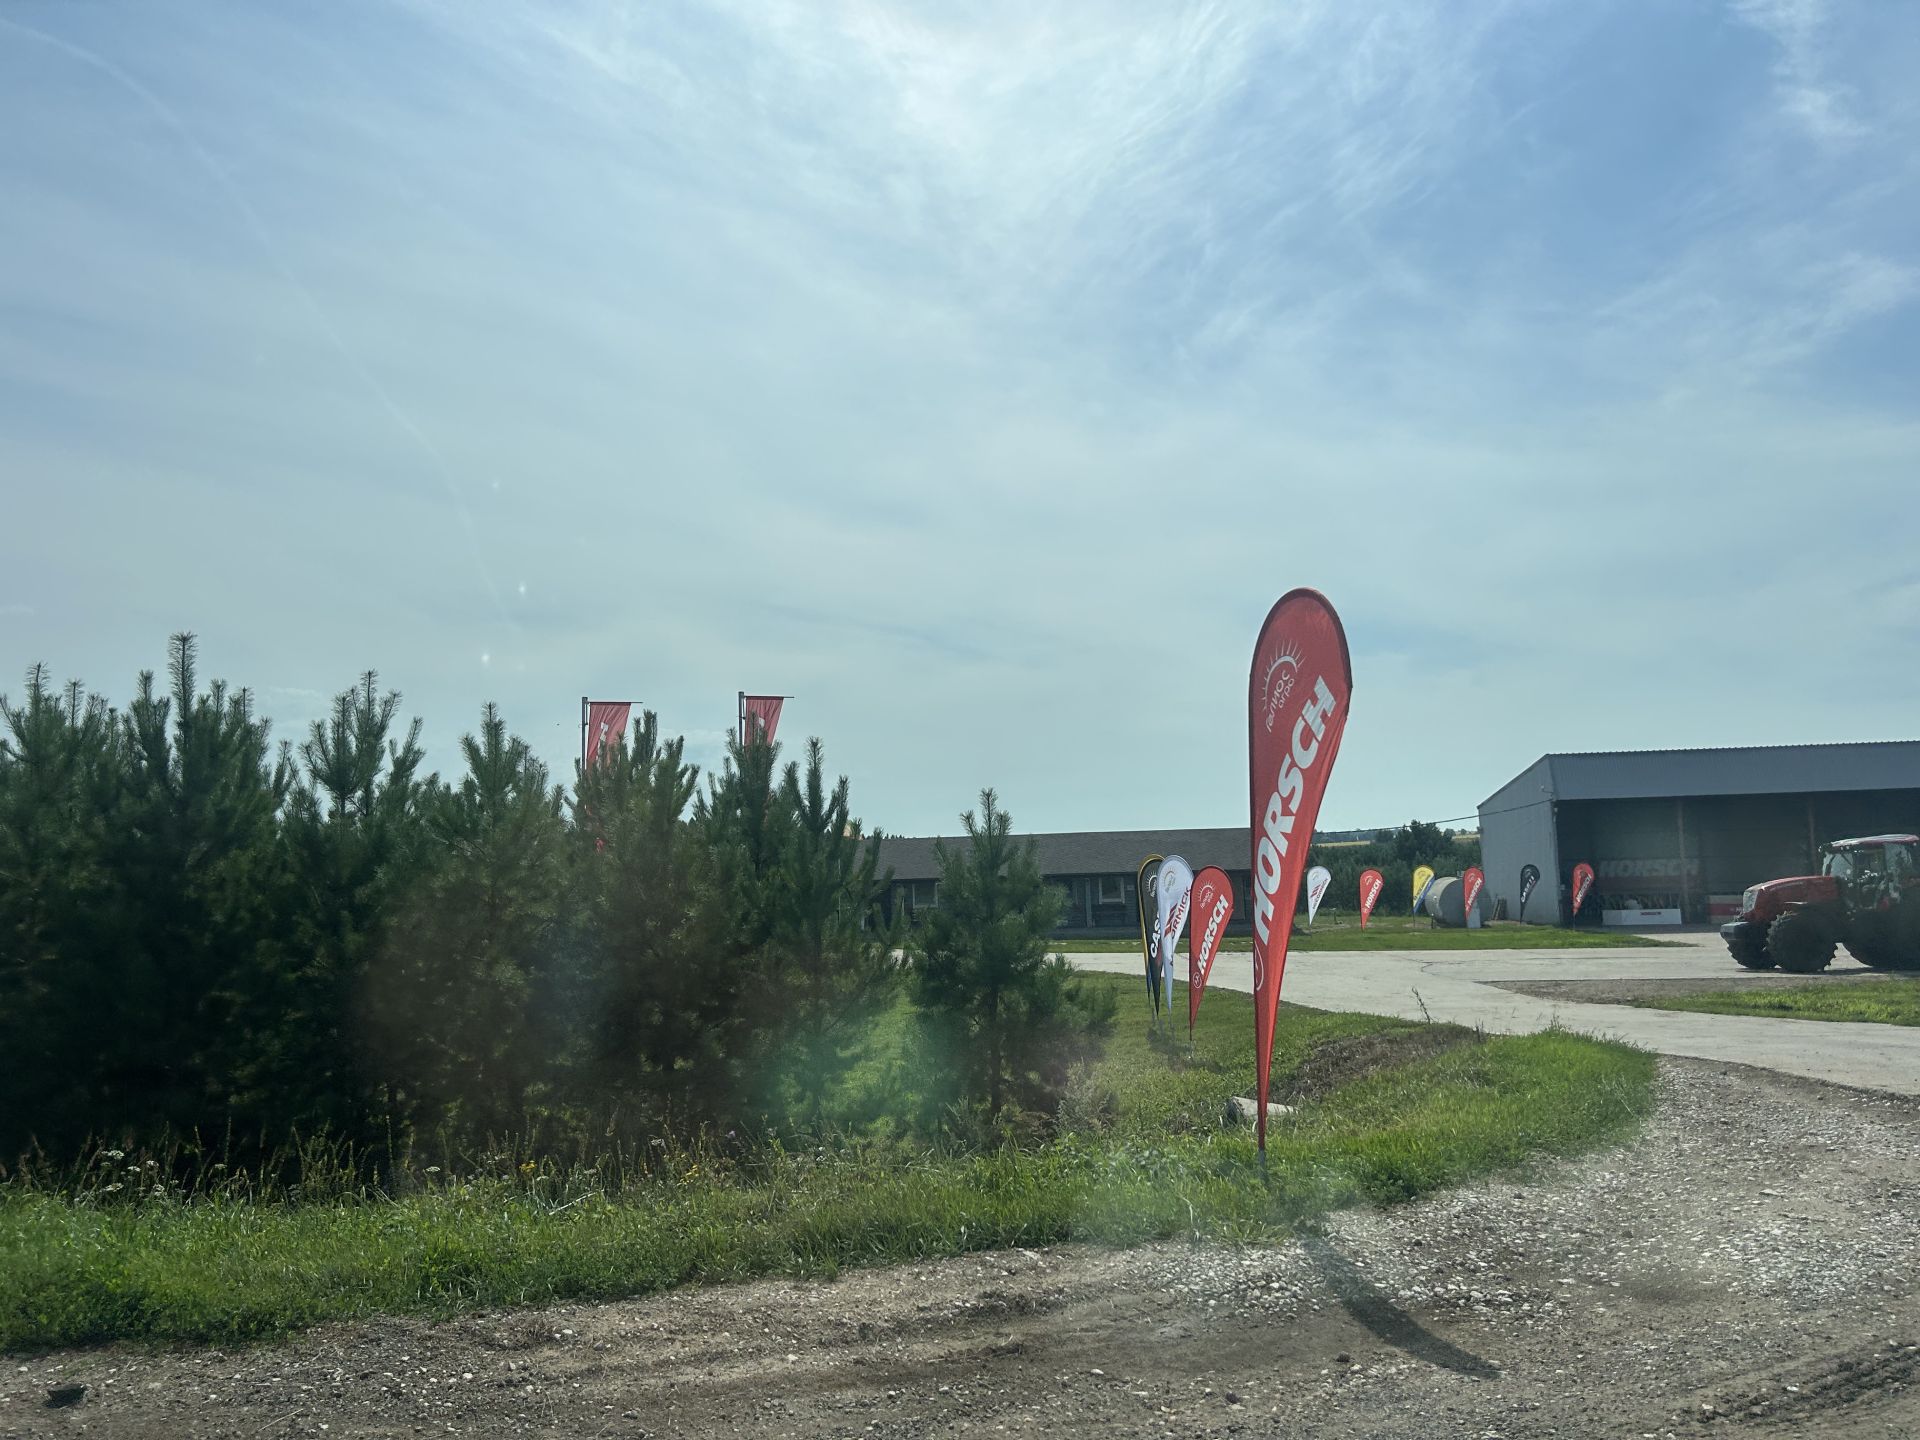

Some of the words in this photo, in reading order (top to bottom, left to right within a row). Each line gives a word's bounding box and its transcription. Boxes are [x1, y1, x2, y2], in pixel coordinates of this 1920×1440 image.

[1279, 678, 1295, 709] агро
[1253, 675, 1336, 946] HORSCH
[1365, 879, 1381, 908] HORSCH
[1468, 878, 1482, 905] HORSCH
[1150, 912, 1160, 958] CAS
[1197, 894, 1229, 974] HORSCH
